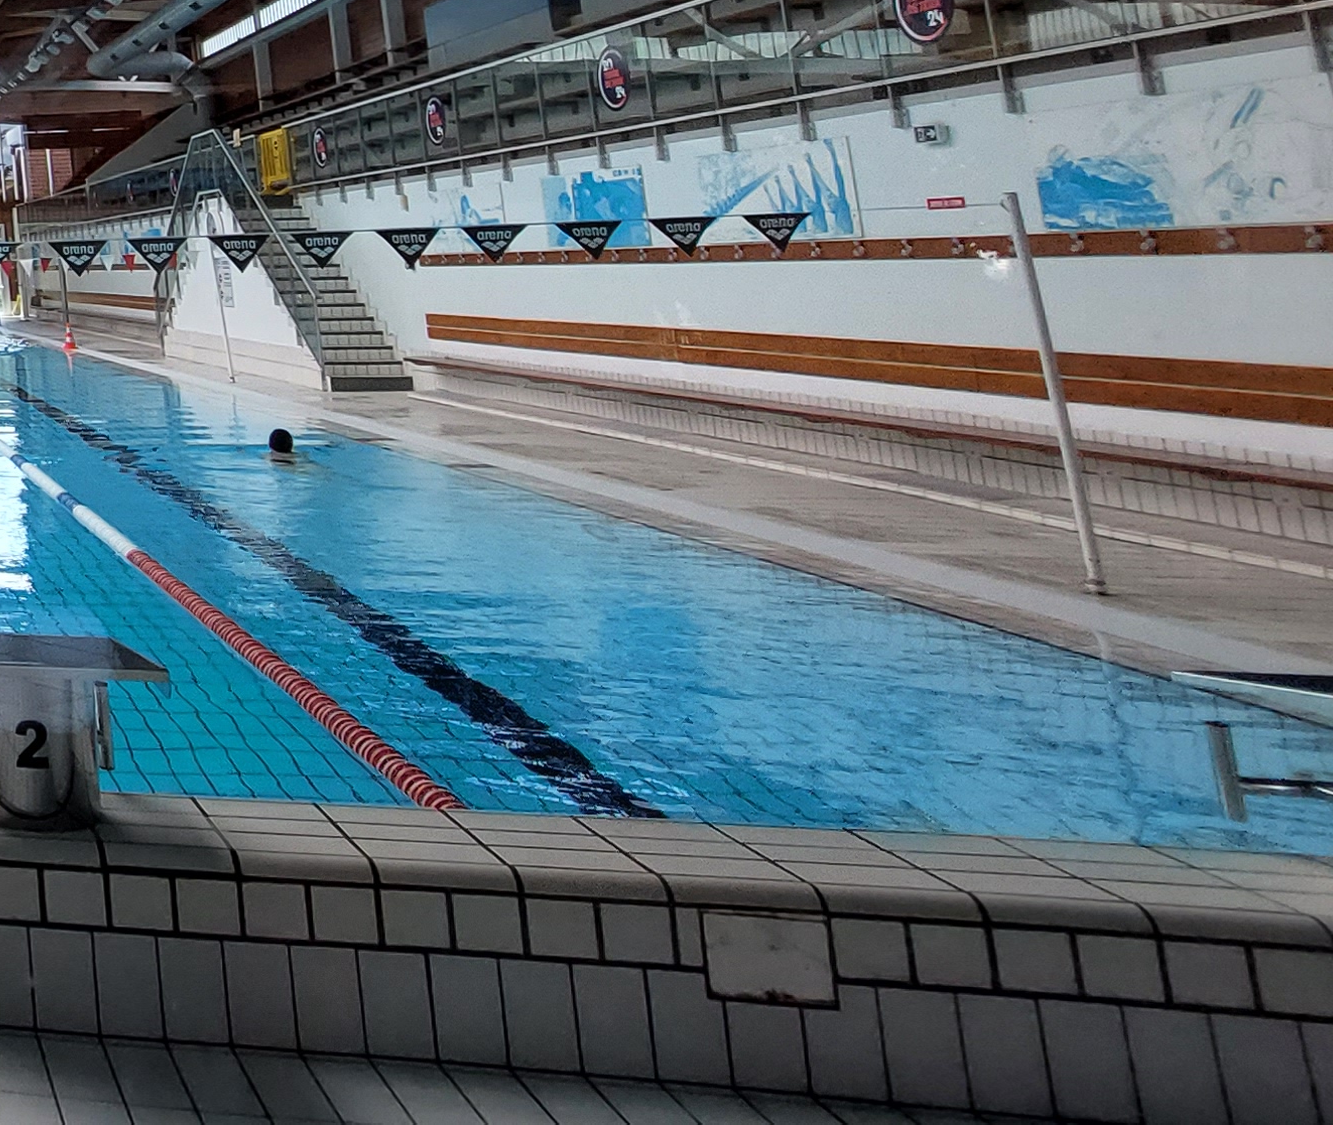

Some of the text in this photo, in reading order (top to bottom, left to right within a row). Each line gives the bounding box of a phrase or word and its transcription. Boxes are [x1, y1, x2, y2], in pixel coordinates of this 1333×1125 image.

[572, 225, 608, 238] arena
[665, 221, 701, 233] arena
[305, 235, 339, 247] arena
[391, 233, 427, 245] arena
[476, 229, 512, 241] arena
[141, 242, 174, 253] arena
[223, 238, 256, 250] arena
[62, 245, 95, 256] arena
[14, 719, 50, 770] 2
